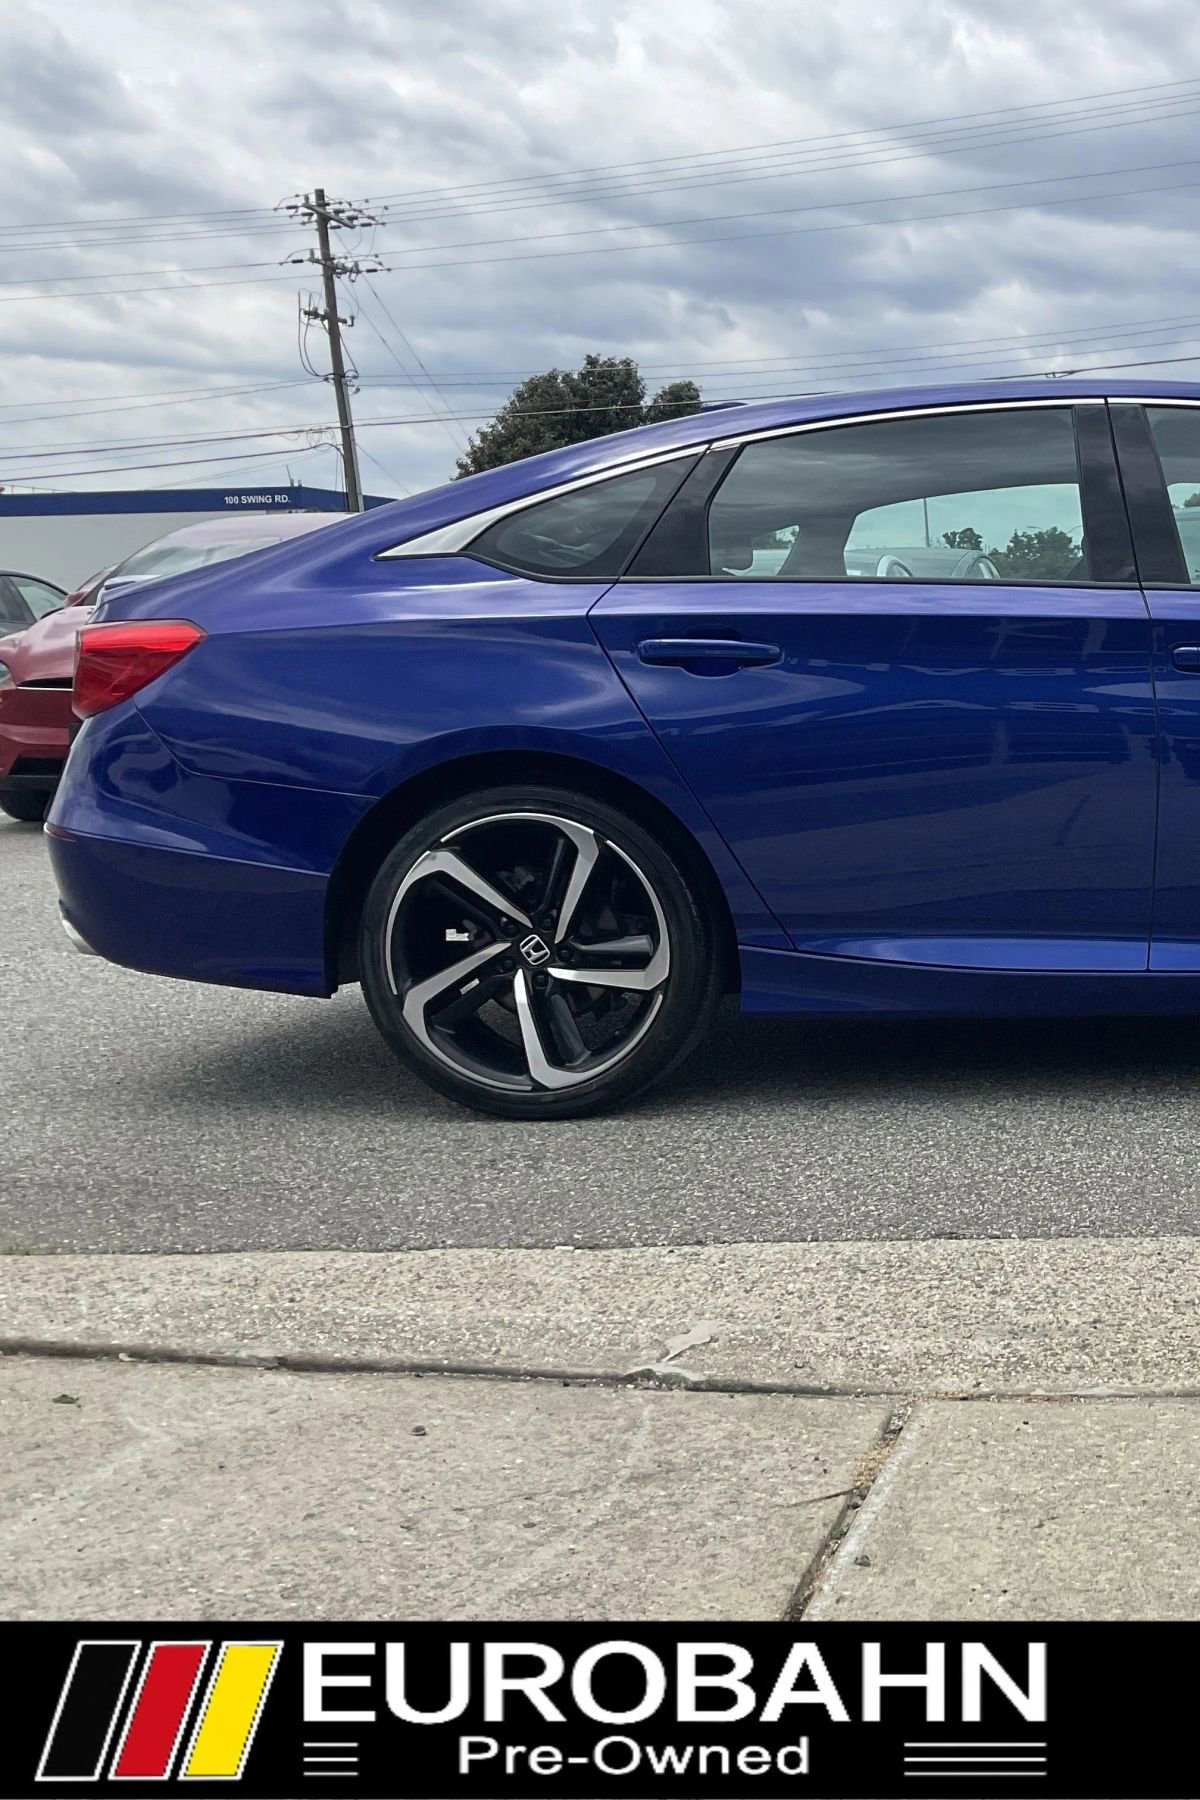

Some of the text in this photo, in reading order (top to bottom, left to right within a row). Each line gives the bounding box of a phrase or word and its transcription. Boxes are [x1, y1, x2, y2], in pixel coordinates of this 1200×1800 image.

[224, 494, 291, 504] 100 SWING RD.
